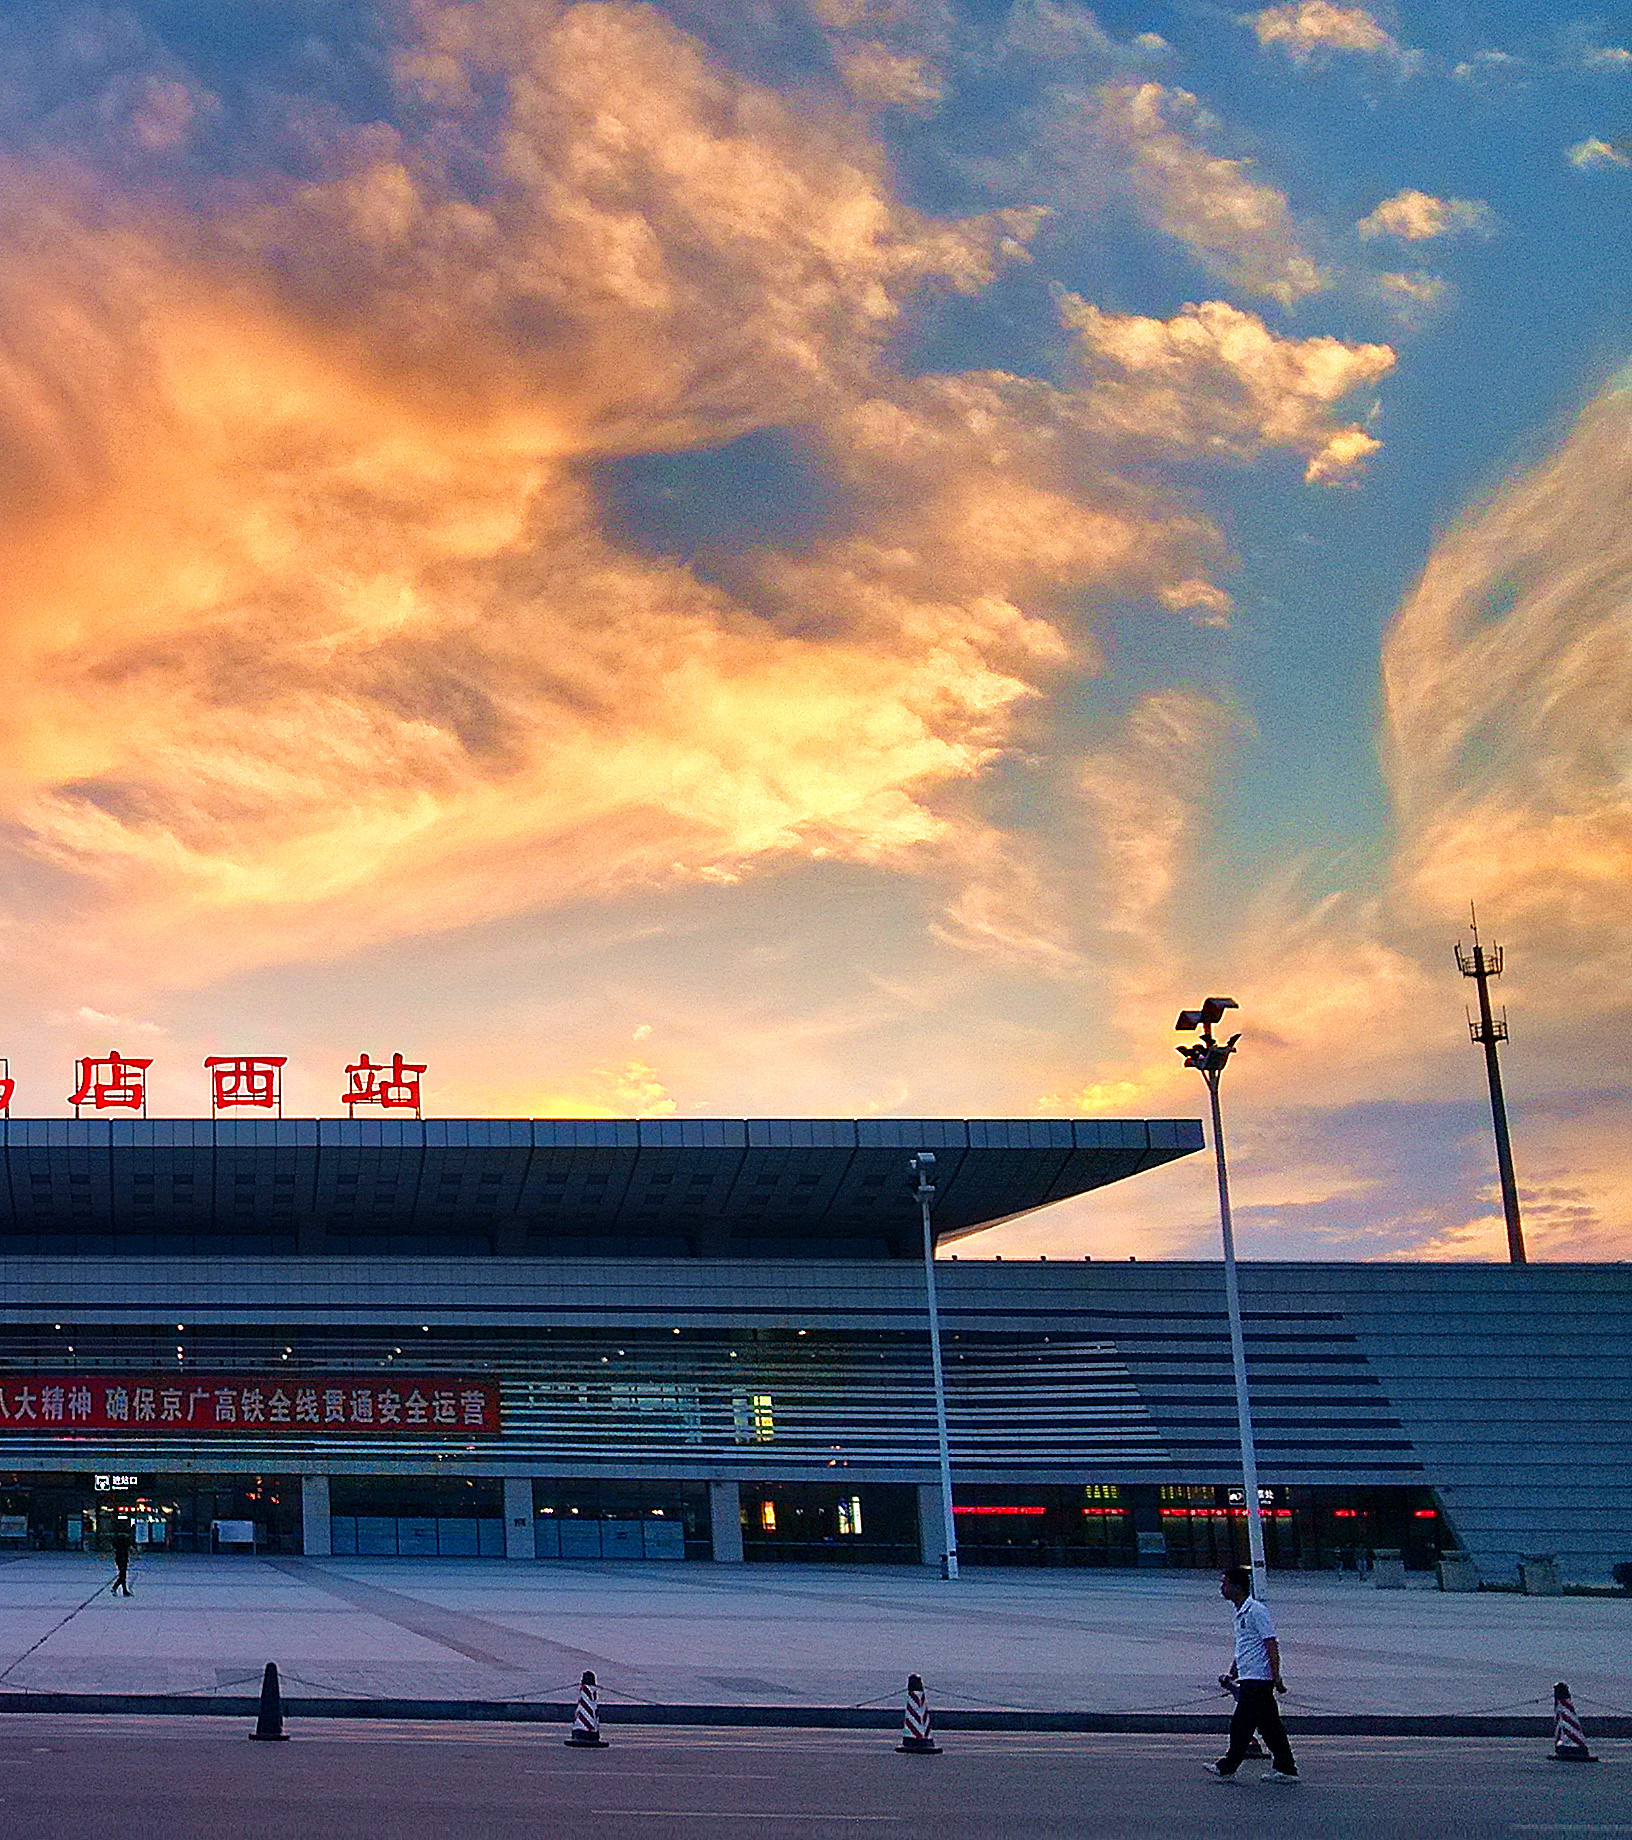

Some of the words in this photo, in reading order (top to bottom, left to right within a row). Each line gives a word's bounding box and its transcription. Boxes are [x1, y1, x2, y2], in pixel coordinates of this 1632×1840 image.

[105, 1385, 487, 1425] 确保京广高铁全线贯通安全运营
